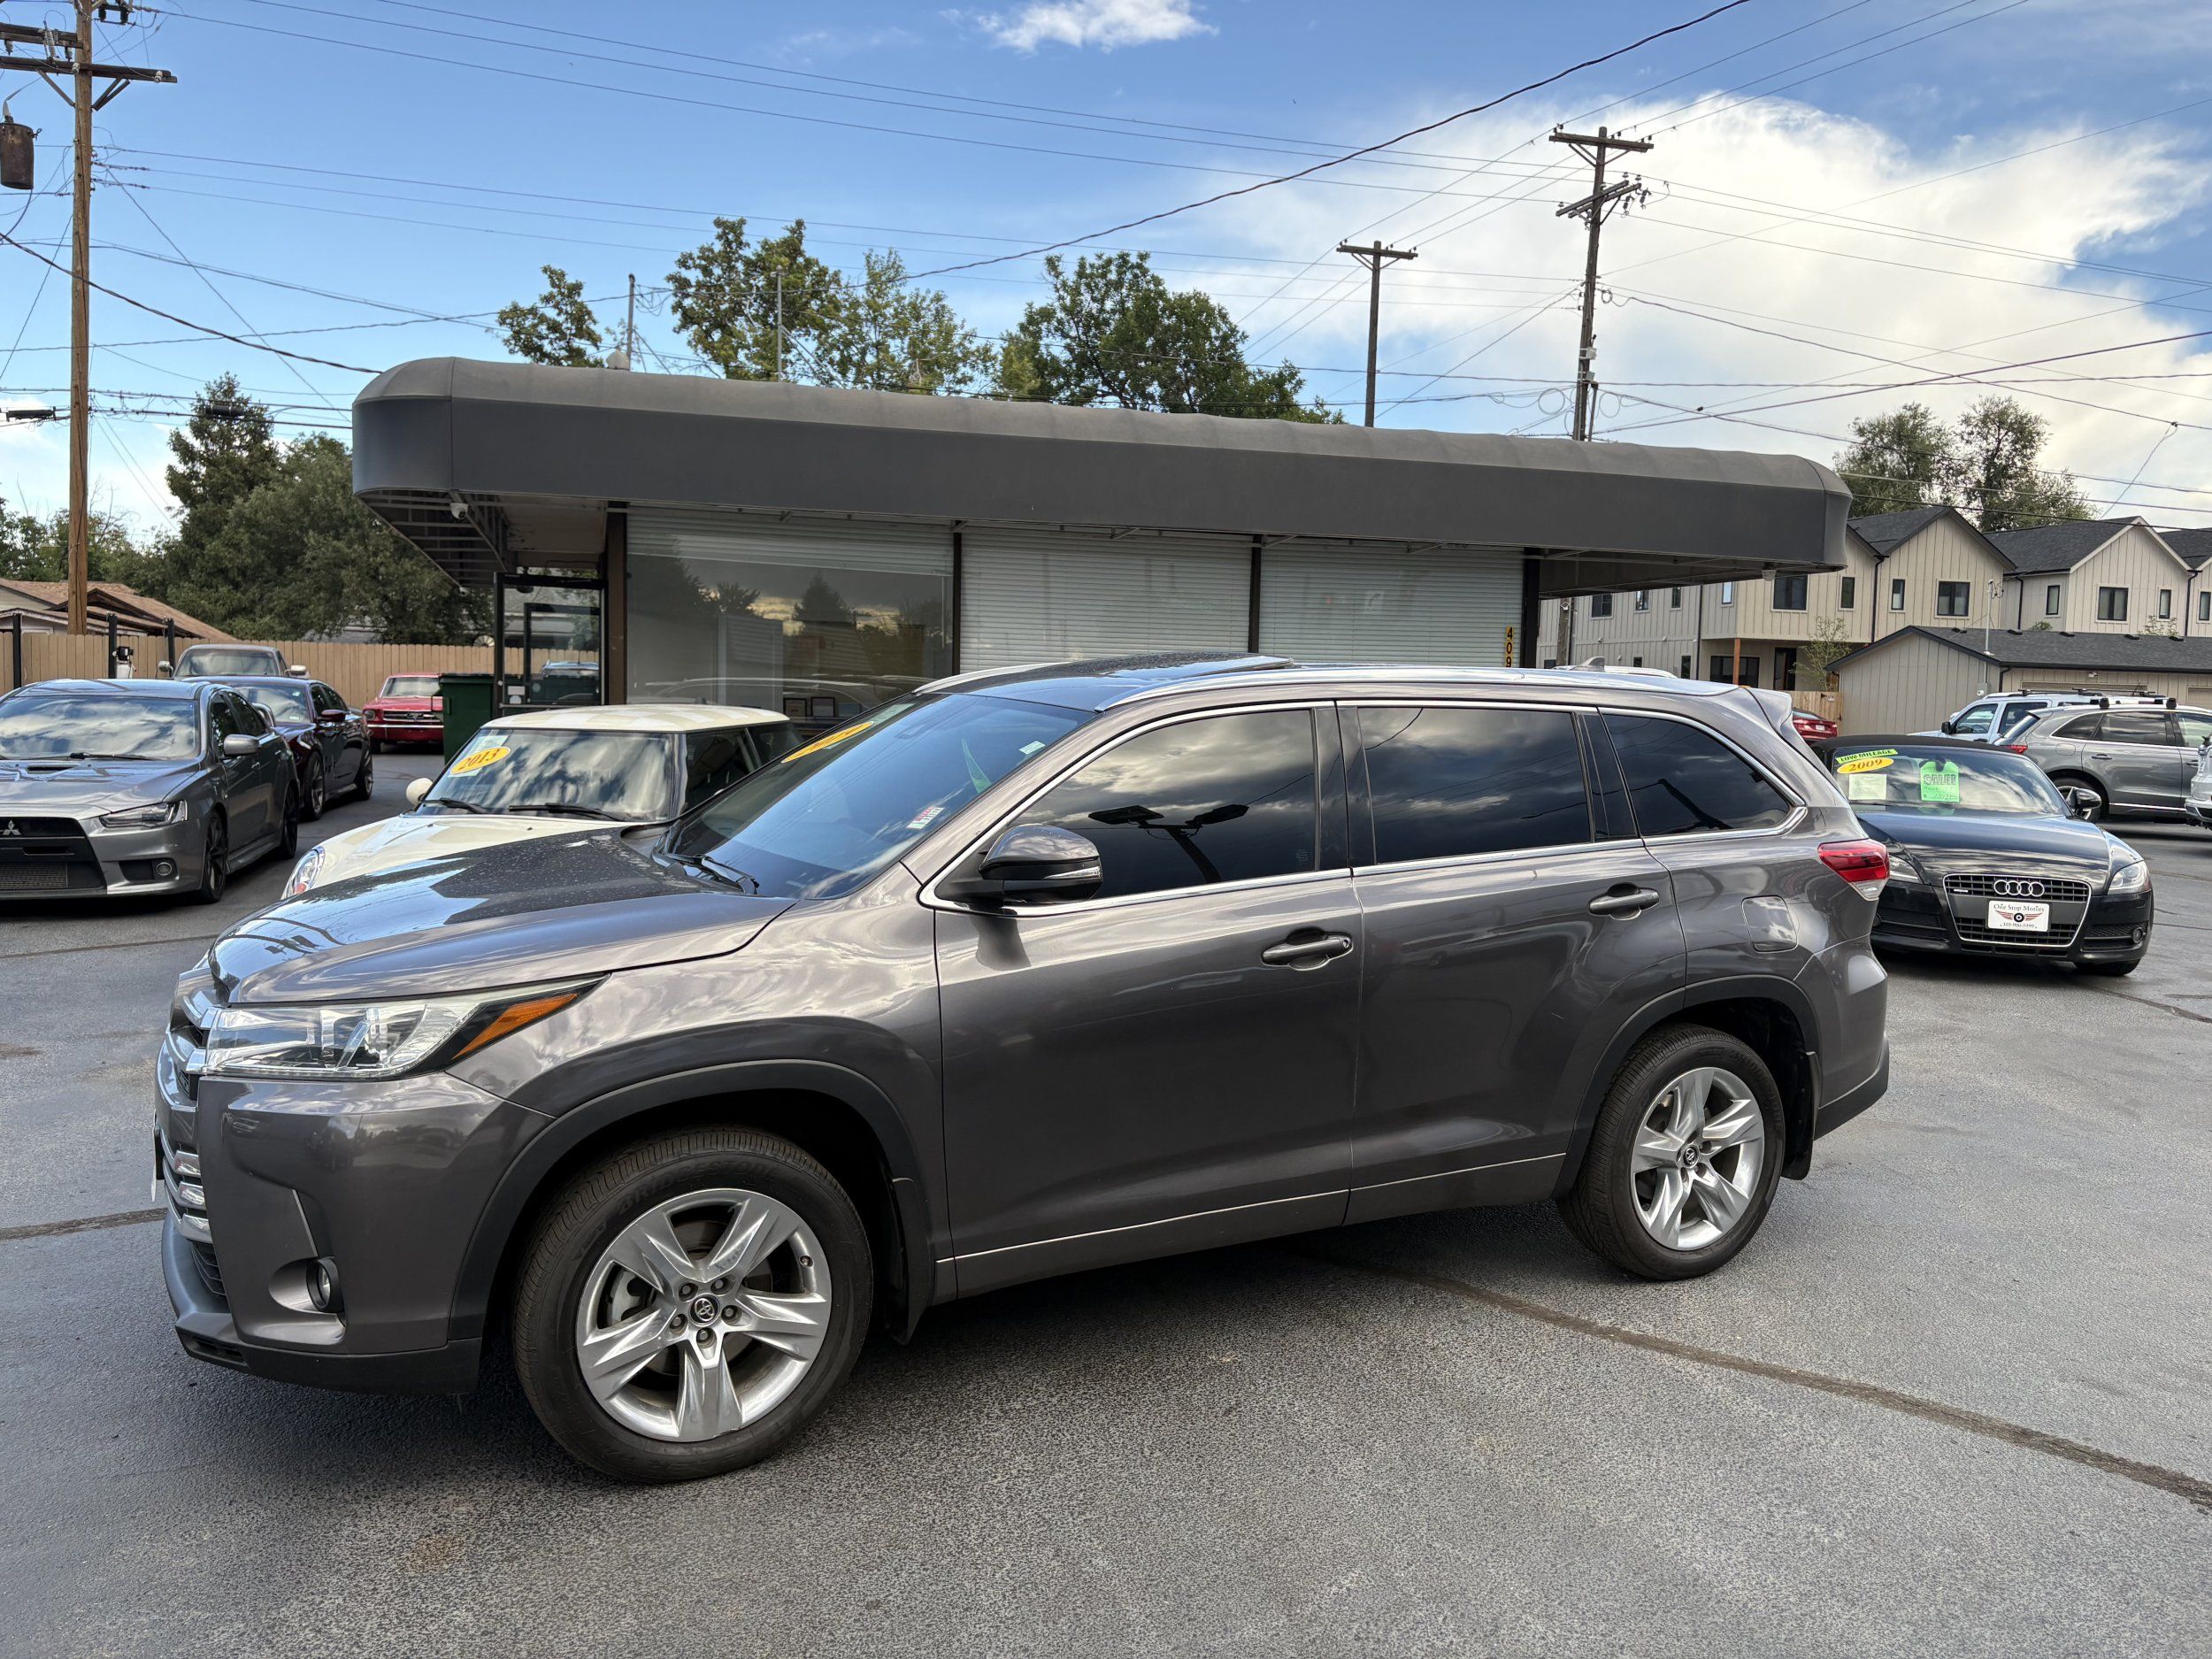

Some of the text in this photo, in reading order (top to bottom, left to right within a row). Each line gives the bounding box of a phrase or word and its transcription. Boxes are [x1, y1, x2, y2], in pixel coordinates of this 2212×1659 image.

[457, 749, 501, 771] 2013
[1859, 749, 1893, 758] MILEAGE
[1848, 758, 1883, 772] 2009
